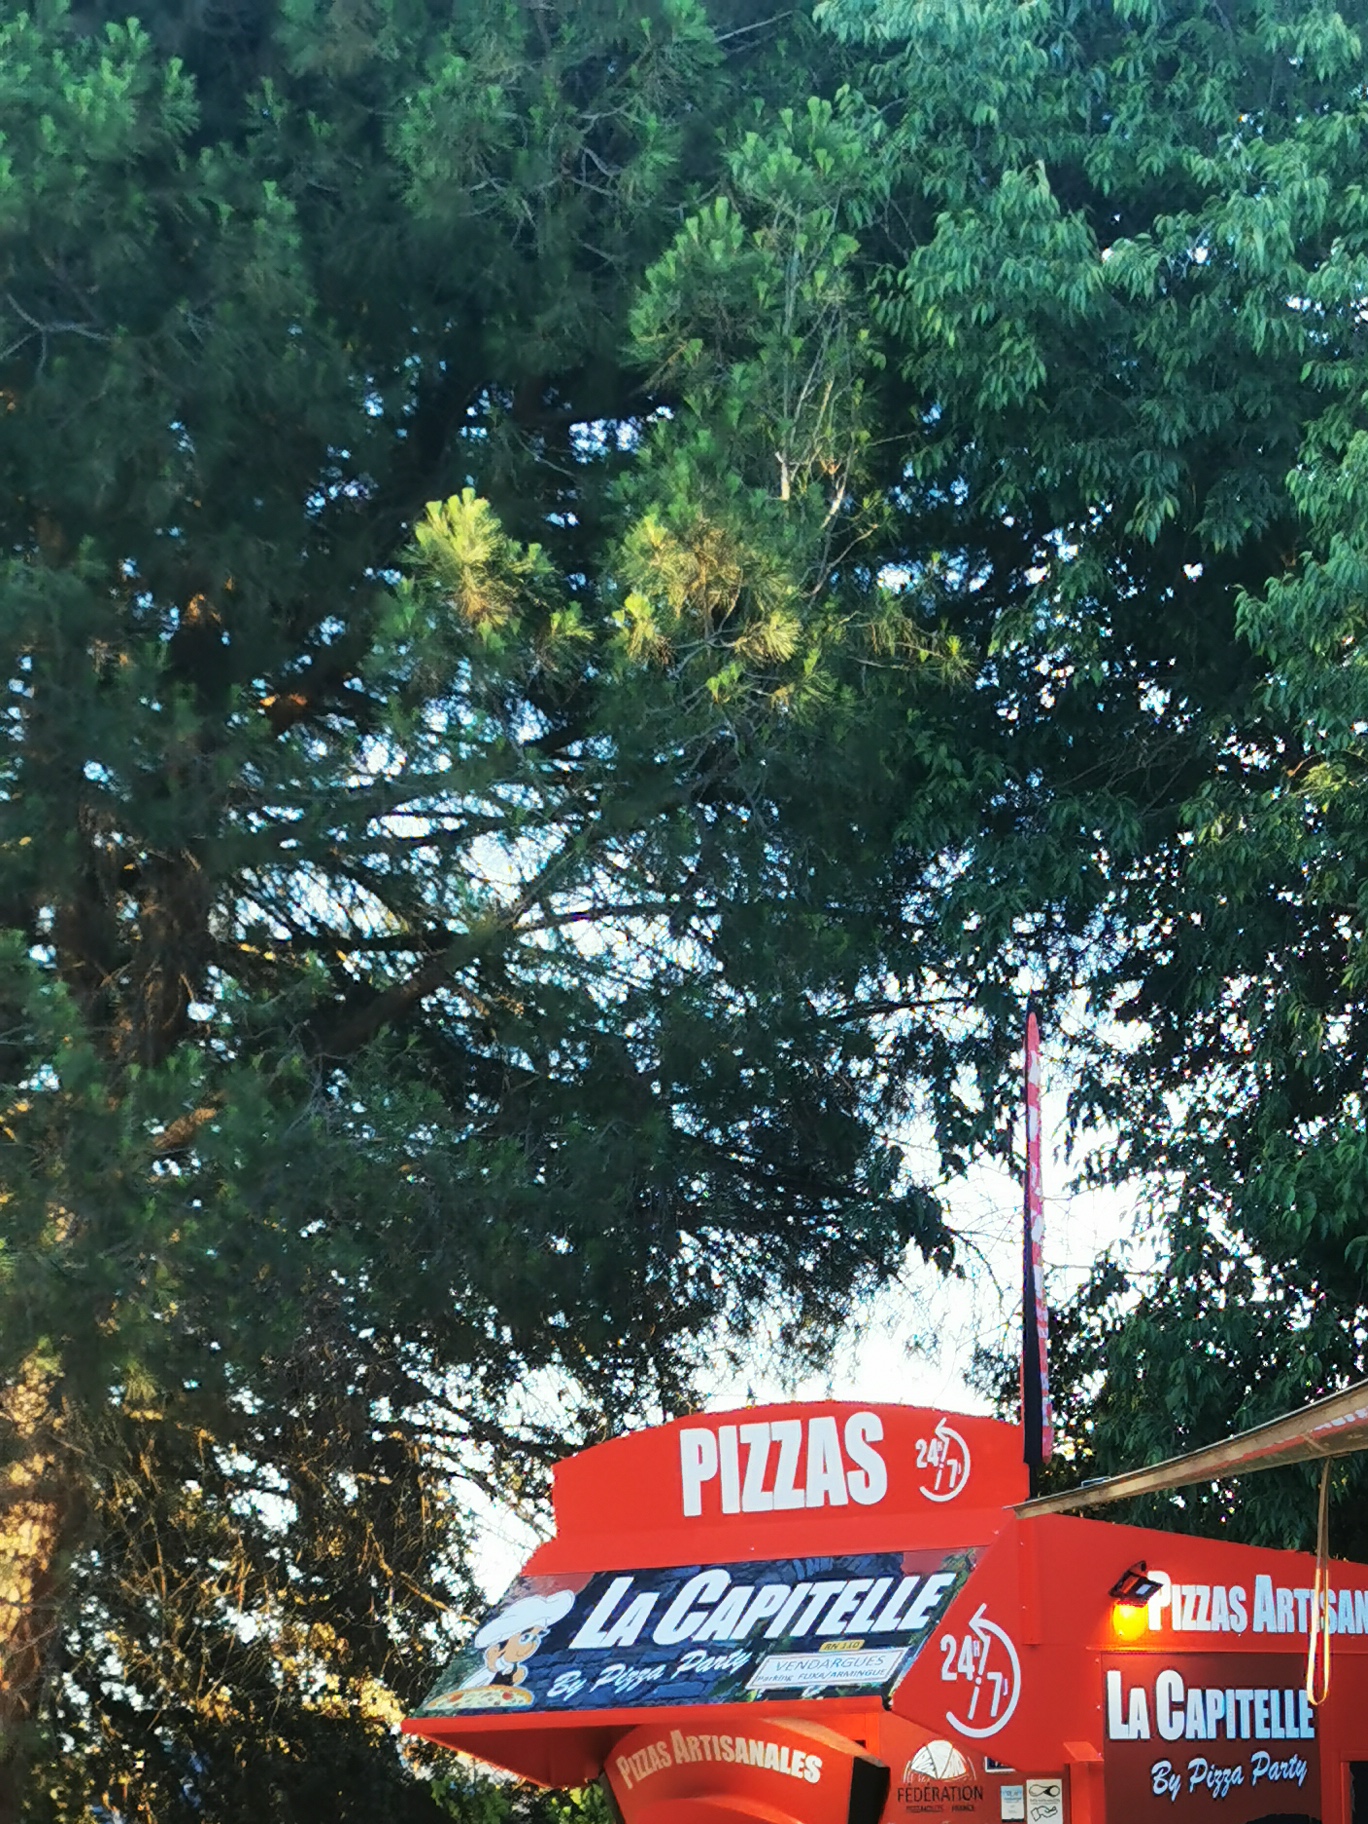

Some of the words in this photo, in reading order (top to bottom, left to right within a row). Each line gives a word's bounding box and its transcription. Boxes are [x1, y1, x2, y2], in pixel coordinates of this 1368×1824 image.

[680, 1411, 888, 1518] PIZZAS
[568, 1576, 661, 1651] LA
[653, 1568, 957, 1646] CAPITELLE
[1147, 1571, 1248, 1633] PIZZAS
[546, 1670, 586, 1702] By
[589, 1663, 666, 1694] Pizza
[670, 1648, 753, 1680] Party
[775, 1655, 887, 1672] VENDARGUES
[1106, 1669, 1151, 1740] LA
[1155, 1669, 1316, 1740] CAPITELLE
[616, 1740, 673, 1790] PIZZAS
[670, 1729, 823, 1784] ARTISANALES
[1151, 1760, 1182, 1801] By
[1187, 1757, 1245, 1798] Pizza
[1250, 1750, 1308, 1787] Party
[897, 1782, 984, 1803] FÉDÉRATION
